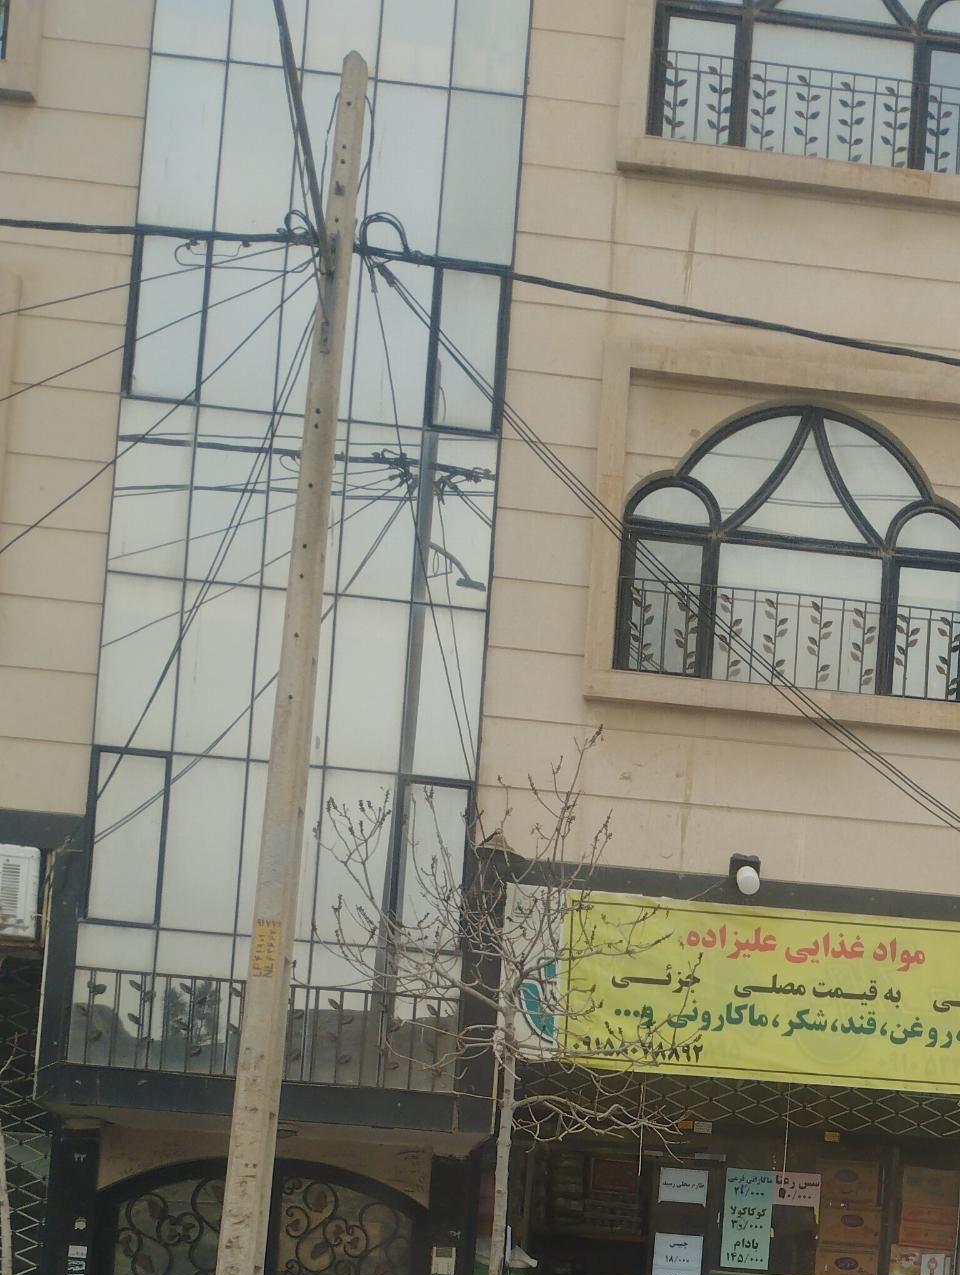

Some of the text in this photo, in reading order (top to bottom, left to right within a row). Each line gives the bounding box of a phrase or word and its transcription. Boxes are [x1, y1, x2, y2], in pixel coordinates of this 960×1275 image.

[686, 927, 926, 972] مواد غذایی علیزاده
[611, 963, 701, 994] جزئی
[811, 980, 878, 1006] قیمت
[883, 983, 902, 1009] به
[666, 999, 769, 1032] ماکارونی
[733, 1238, 759, 1252] بادام
